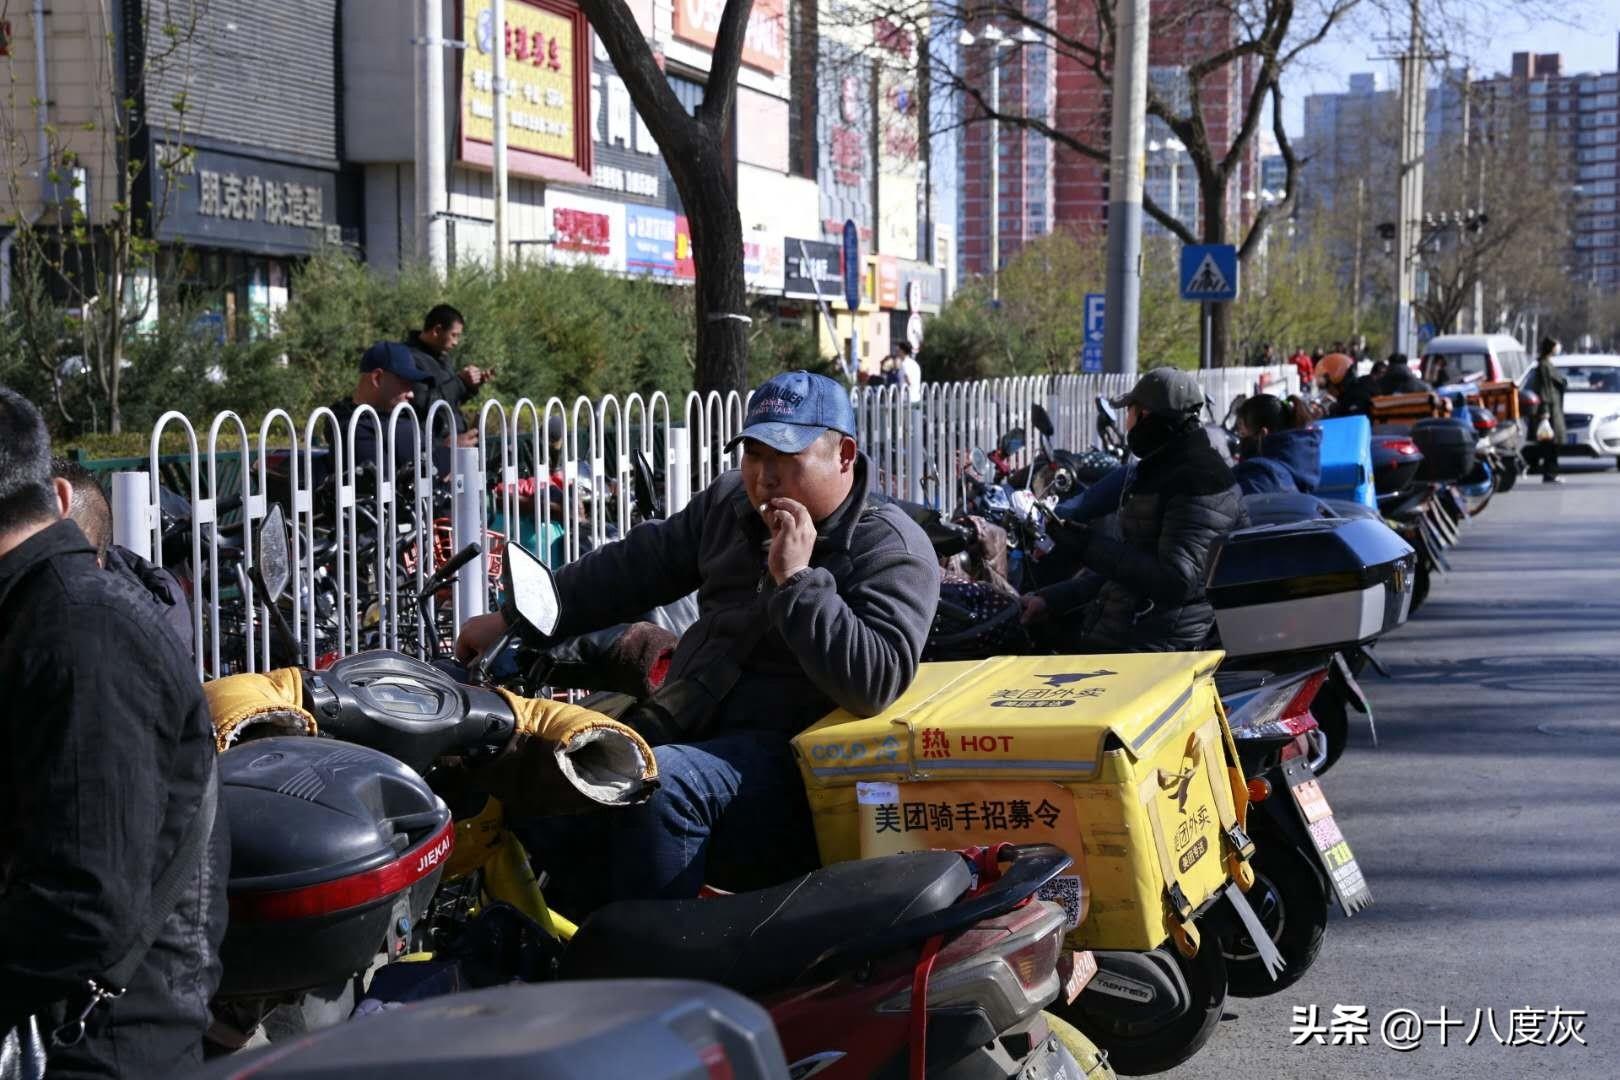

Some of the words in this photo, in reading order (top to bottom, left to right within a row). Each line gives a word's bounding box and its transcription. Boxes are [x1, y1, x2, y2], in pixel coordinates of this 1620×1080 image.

[200, 170, 324, 229] 朋克护肤造型
[987, 687, 1107, 699] 美团外卖
[811, 743, 867, 760] COLD
[875, 735, 899, 760] 冷
[922, 727, 951, 759] 热
[960, 735, 1014, 753] HOT
[874, 799, 1062, 834] 美团骑手招募令
[417, 835, 450, 872] JIEKAI
